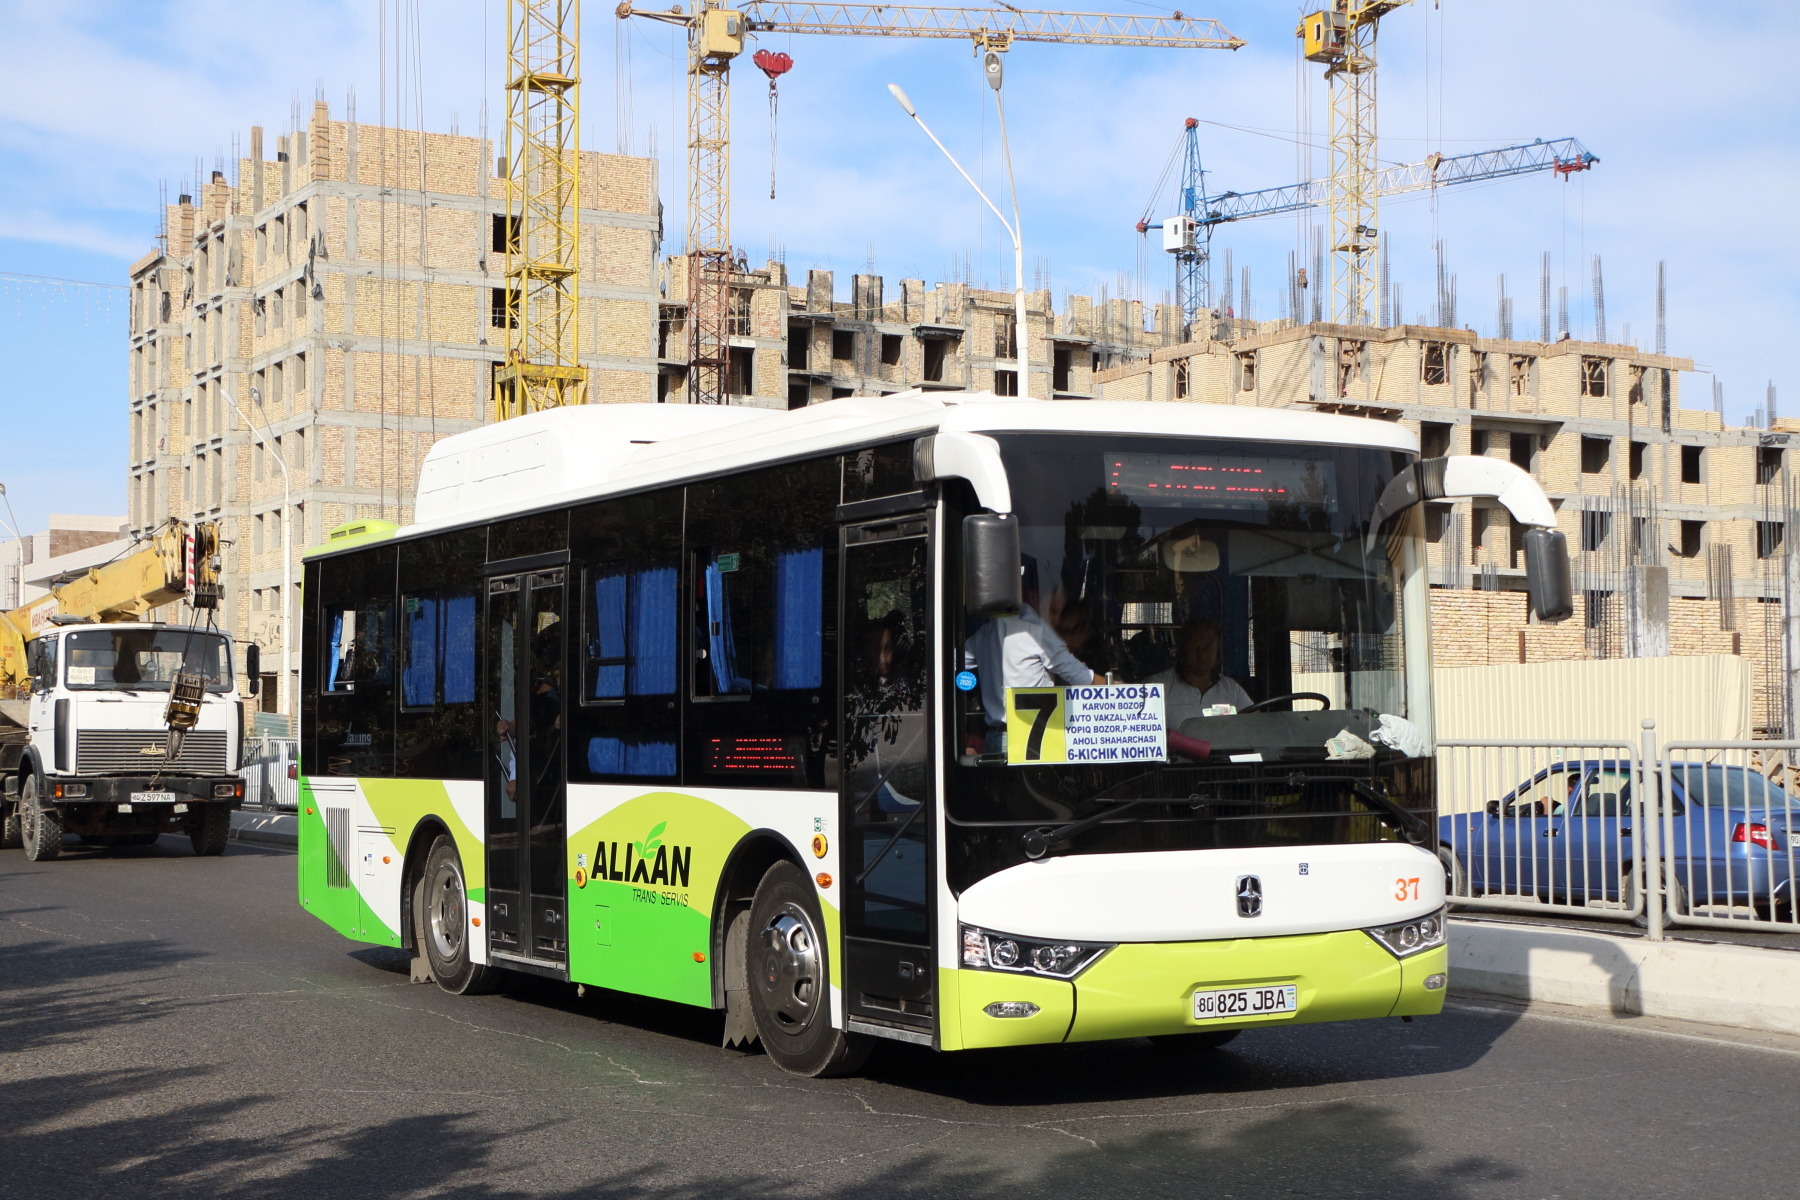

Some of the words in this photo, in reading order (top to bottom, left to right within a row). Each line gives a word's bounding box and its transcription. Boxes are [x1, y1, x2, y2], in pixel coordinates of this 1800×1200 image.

[1082, 702, 1116, 711] KARVON
[1117, 701, 1144, 710] BOZOR
[1014, 693, 1058, 761] 7
[1069, 714, 1092, 723] AVTO
[1065, 725, 1092, 734] YOPIQ
[1072, 736, 1098, 745] AHOLI
[1100, 735, 1157, 744] SHAHARCHASI
[1067, 747, 1119, 761] 6-KICHIK
[1121, 746, 1163, 760] NOHIYA
[590, 840, 692, 888] ALIXAN
[632, 888, 657, 905] TRANS
[660, 890, 689, 908] SERVIS
[1394, 877, 1420, 902] 37
[1198, 996, 1214, 1013] 80
[1217, 991, 1248, 1014] 825
[1252, 989, 1286, 1011] JBA
